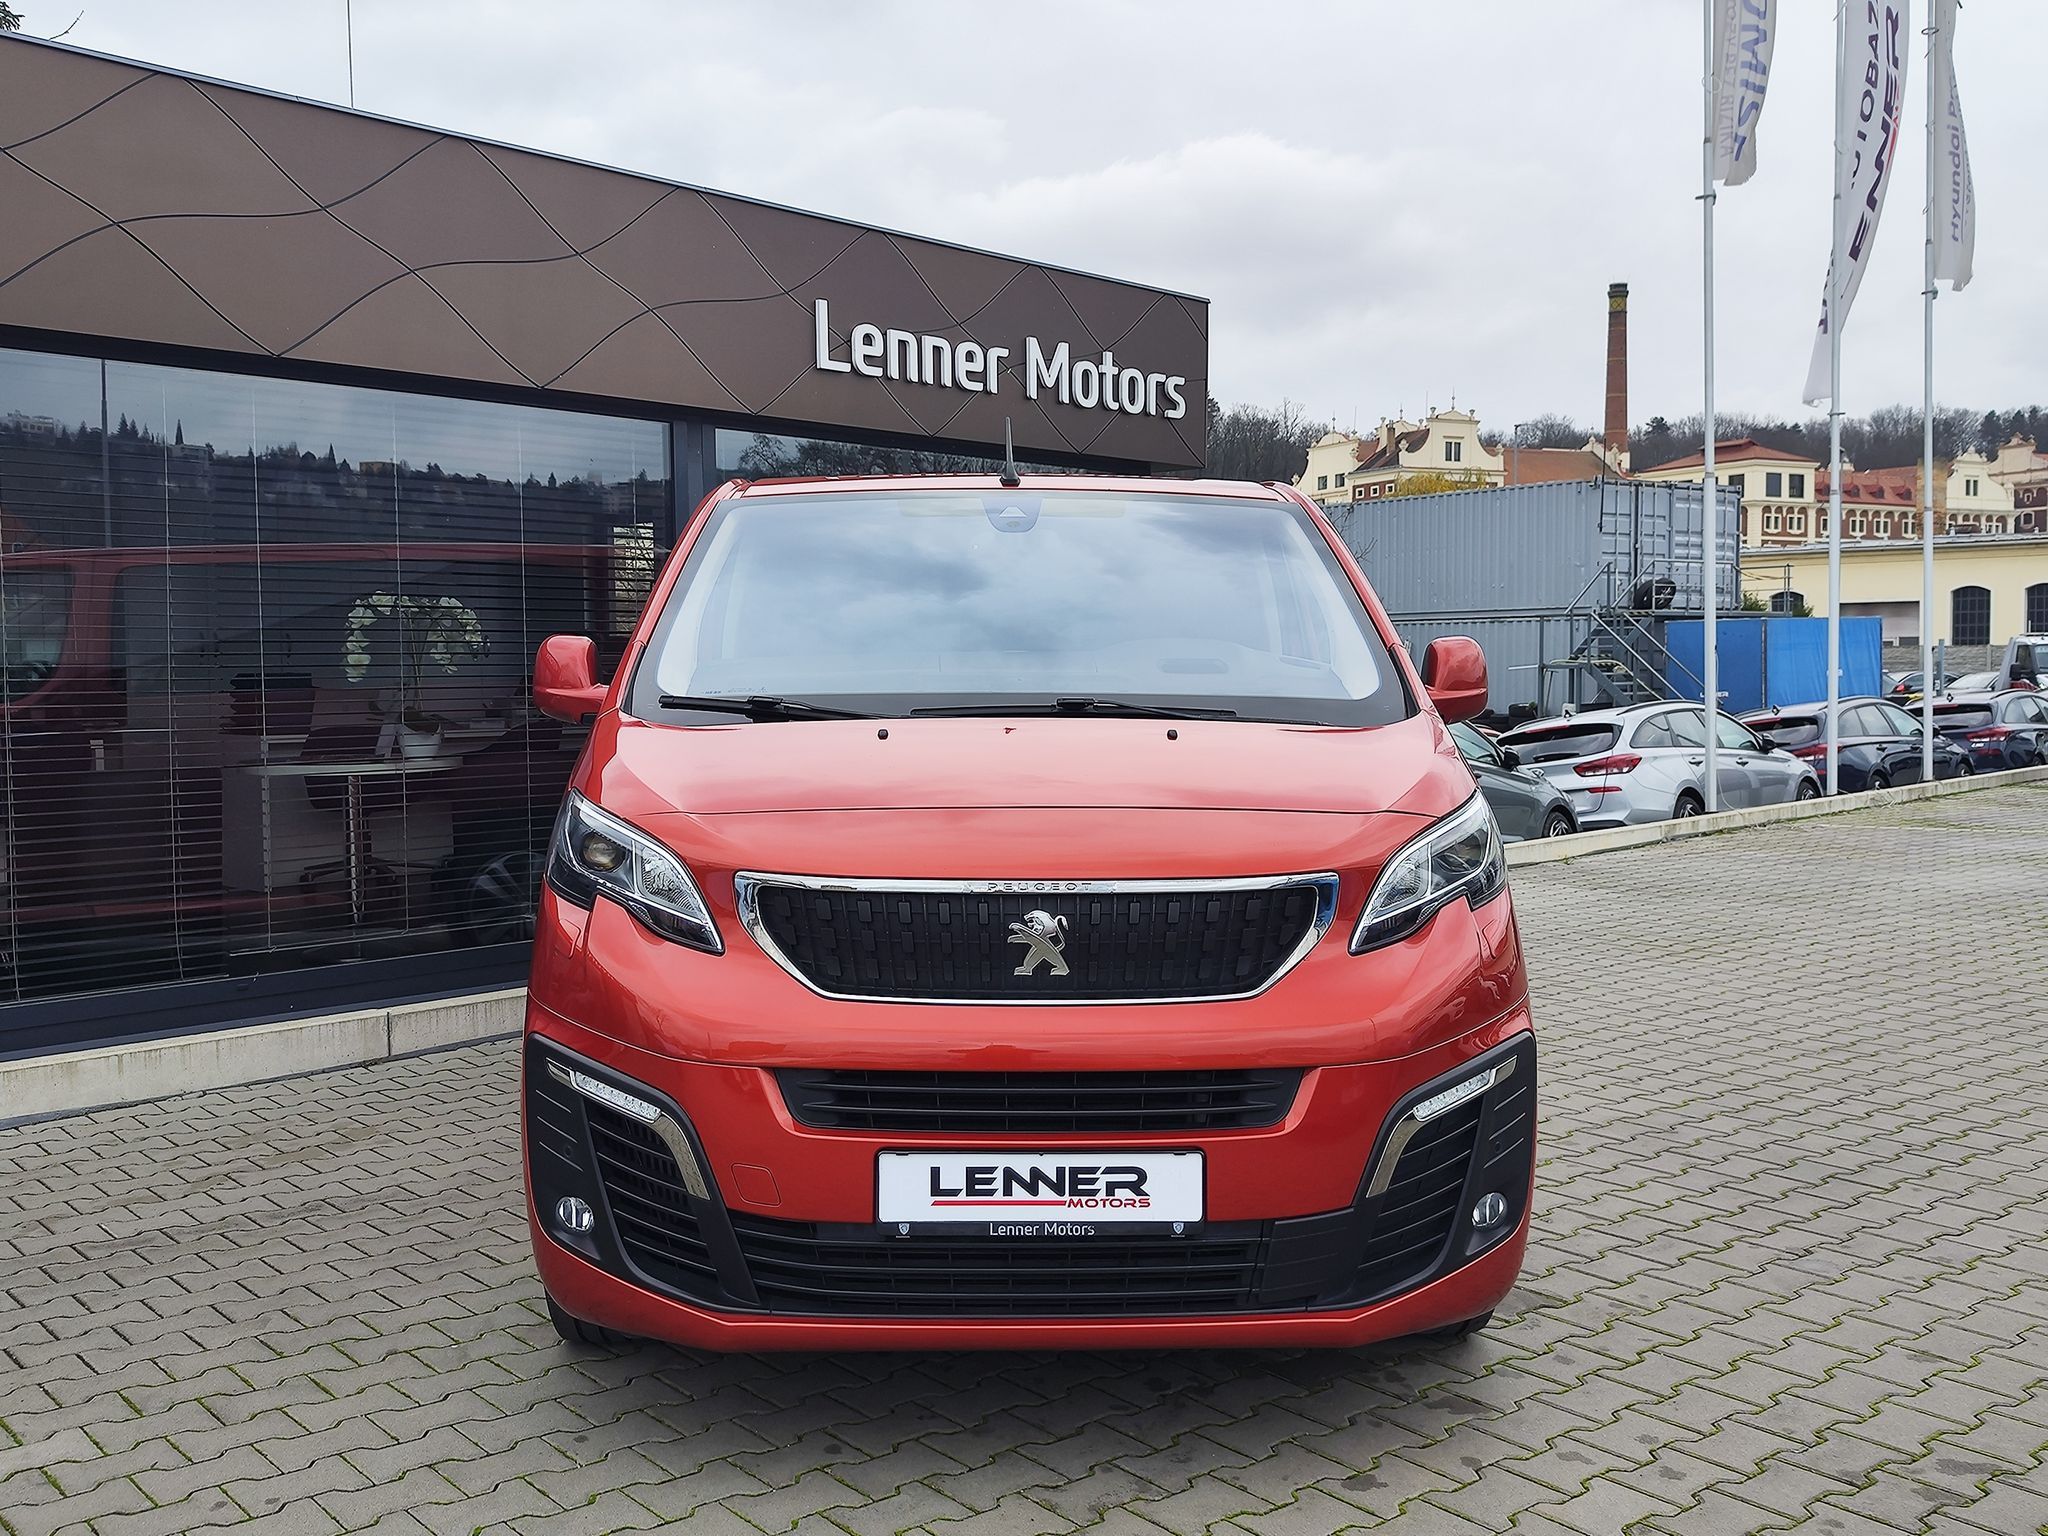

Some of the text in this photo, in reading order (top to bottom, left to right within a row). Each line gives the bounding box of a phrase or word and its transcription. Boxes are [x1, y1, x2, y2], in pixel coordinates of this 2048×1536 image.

[1946, 124, 1962, 243] Hyundai
[815, 298, 1187, 420] Lenner Motors
[987, 882, 1092, 891] PEUGEOT
[930, 1165, 1151, 1197] LENNER
[1066, 1198, 1151, 1208] MOTORS
[989, 1223, 1096, 1236] Lenner Motors
